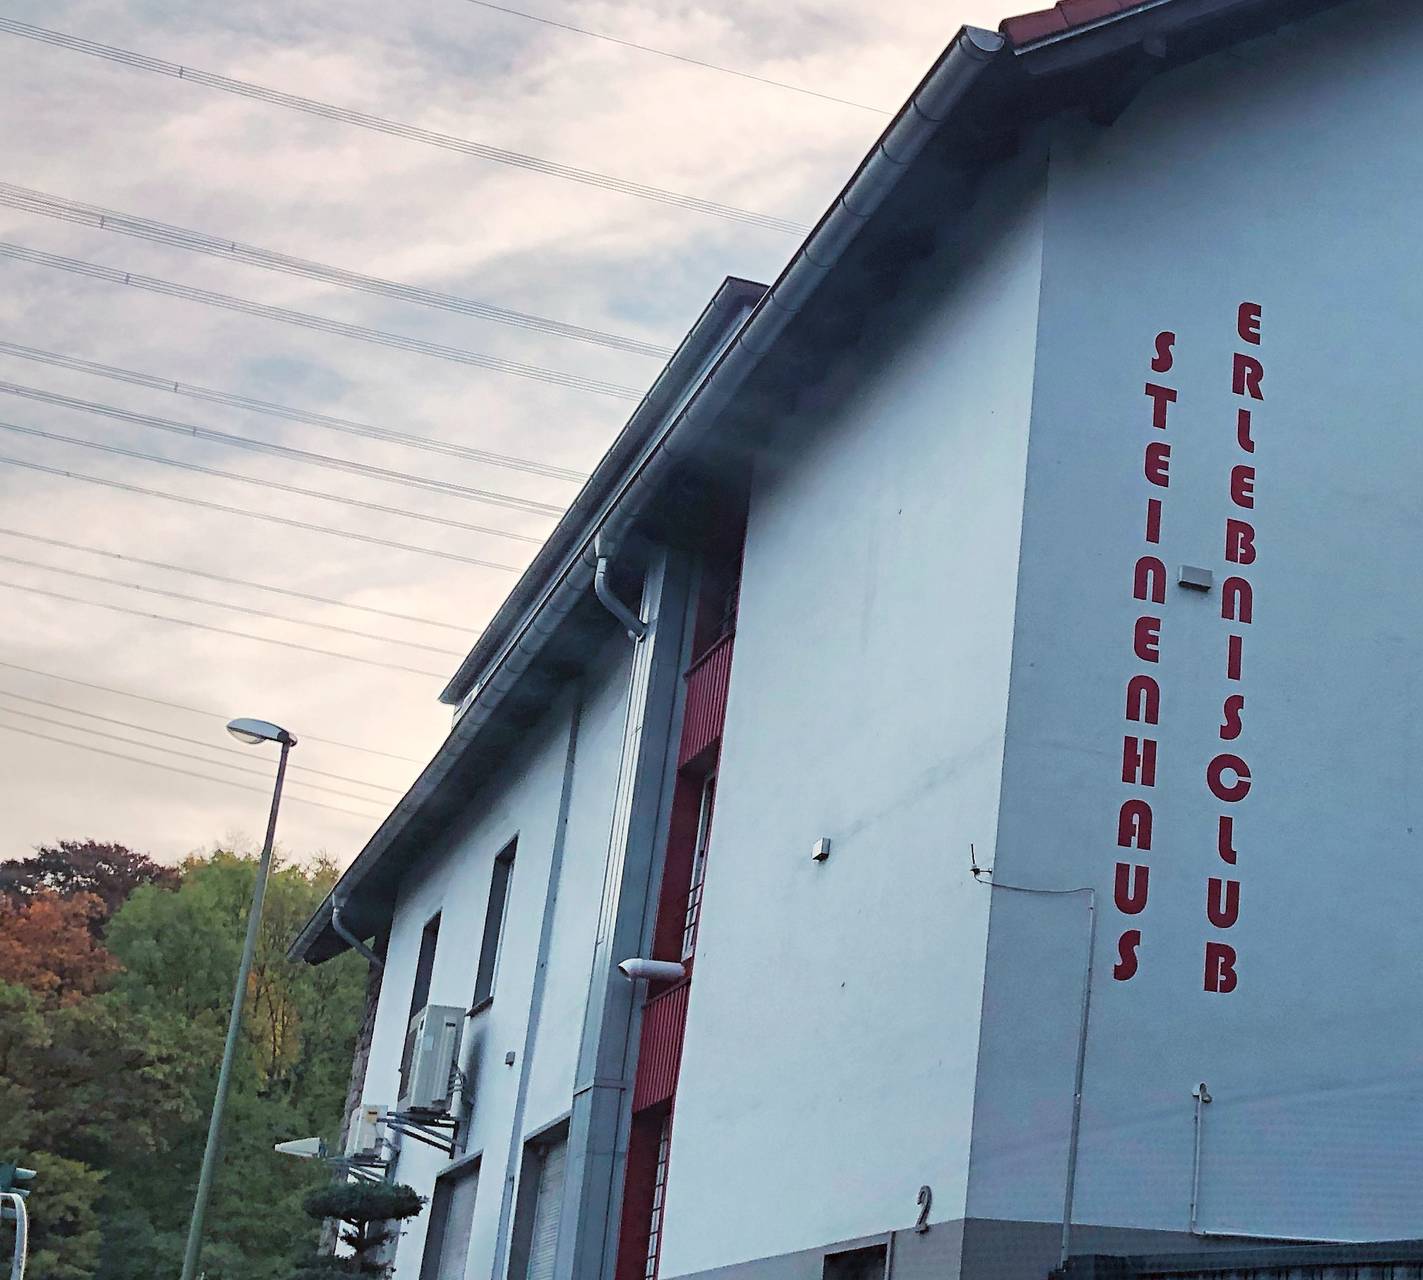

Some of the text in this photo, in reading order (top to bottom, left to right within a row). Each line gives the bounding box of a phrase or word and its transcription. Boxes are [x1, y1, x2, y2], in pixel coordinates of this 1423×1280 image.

[1113, 331, 1178, 981] STEINENHAUS
[1203, 301, 1264, 994] ERLEBNISCLUB
[914, 1184, 932, 1233] 2
